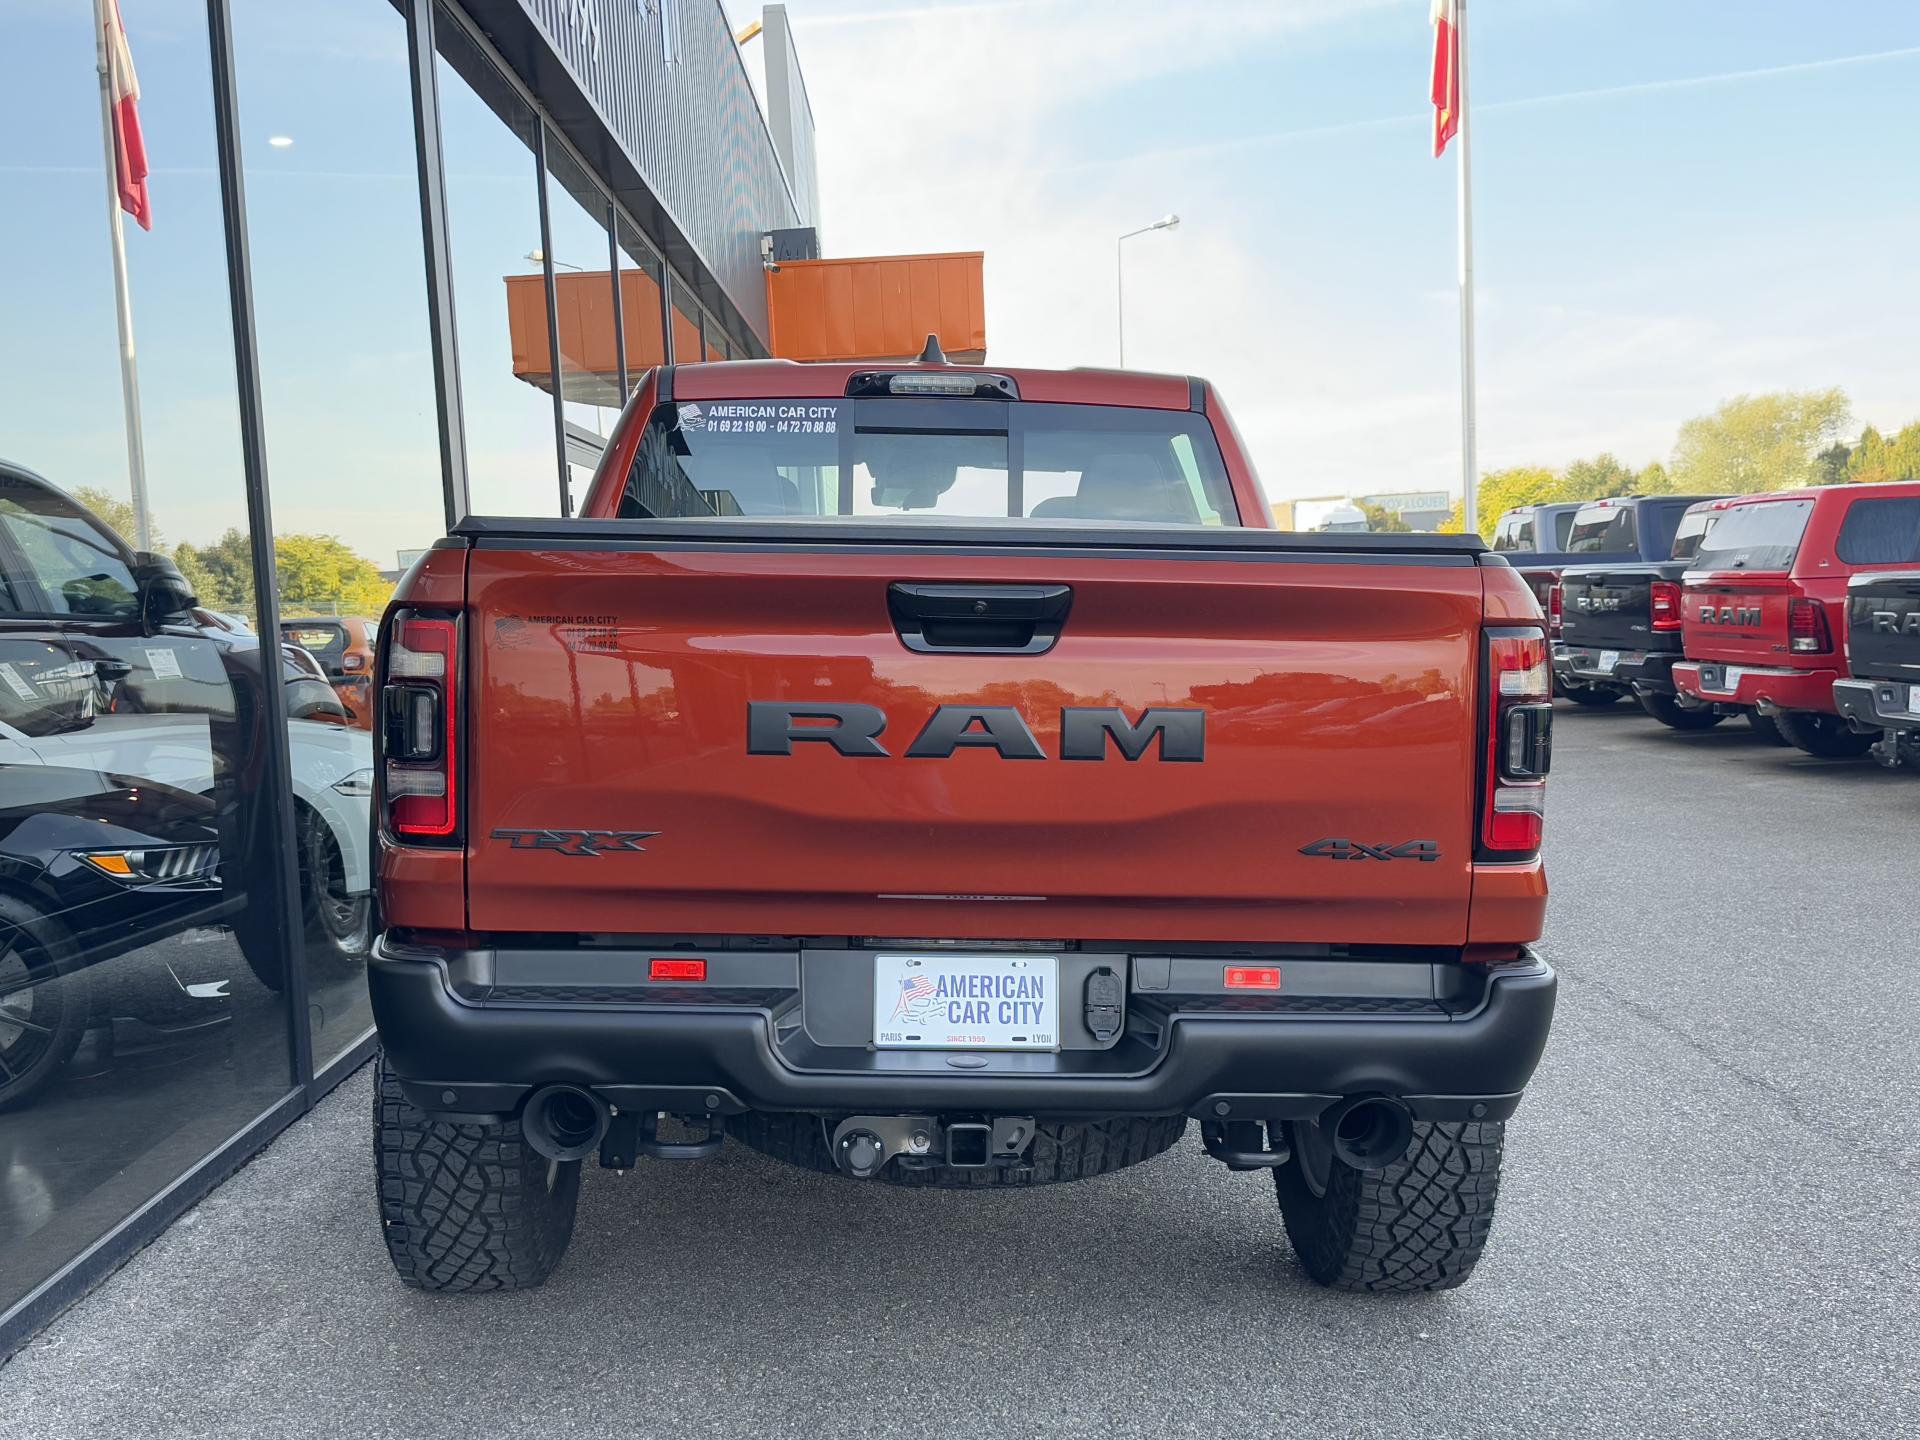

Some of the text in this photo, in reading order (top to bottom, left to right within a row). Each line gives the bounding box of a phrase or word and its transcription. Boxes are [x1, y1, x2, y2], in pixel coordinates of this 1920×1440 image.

[709, 406, 837, 418] AMERICAN CAR CITY
[708, 420, 717, 432] 01
[720, 420, 730, 432] 69
[732, 420, 742, 432] 22
[745, 420, 754, 432] 19
[756, 421, 767, 432] 00
[777, 421, 787, 433] 04
[790, 421, 800, 433] 72
[802, 421, 812, 433] 70
[1577, 597, 1619, 611] RAM
[528, 615, 618, 625] AMERICAN CAR CITY
[1699, 605, 1762, 627] RAM
[747, 701, 1206, 762] RAM
[490, 828, 662, 856] TRX
[936, 975, 1044, 998] AMERICAN
[948, 1001, 1044, 1025] CAR CITY
[880, 1032, 902, 1042] PARIS
[946, 1035, 966, 1043] SINCE
[1032, 1033, 1052, 1043] LYON
